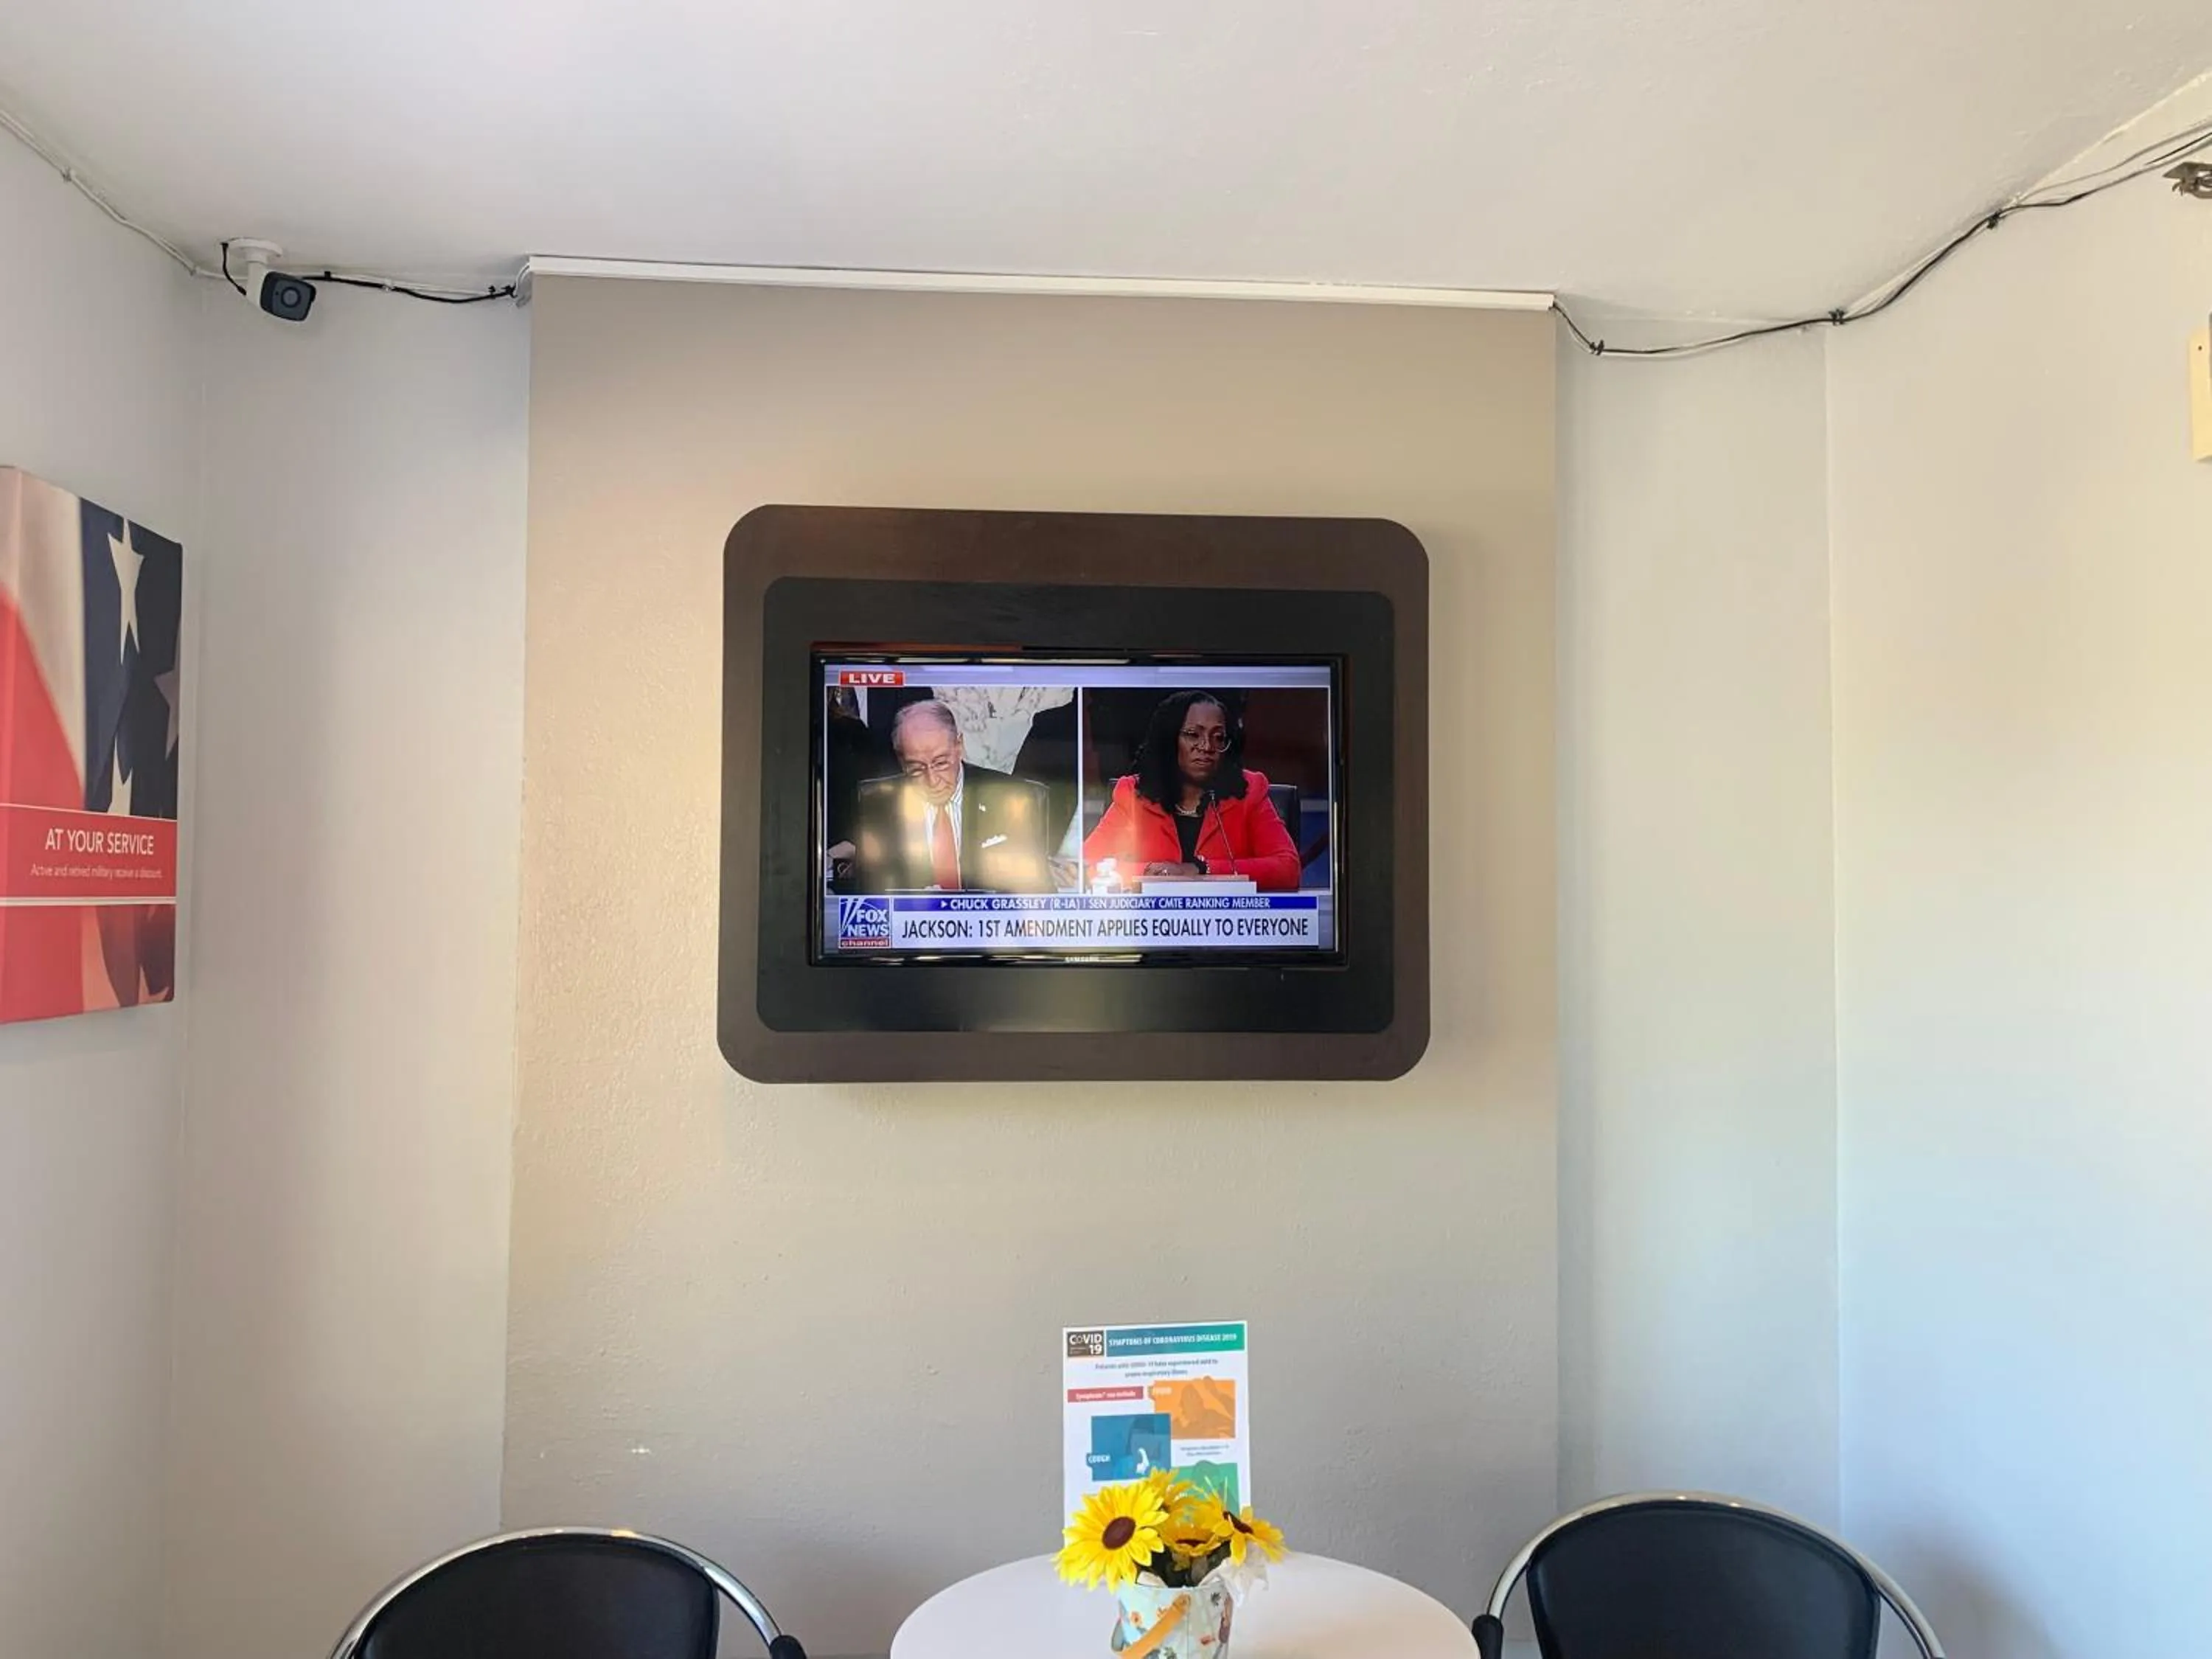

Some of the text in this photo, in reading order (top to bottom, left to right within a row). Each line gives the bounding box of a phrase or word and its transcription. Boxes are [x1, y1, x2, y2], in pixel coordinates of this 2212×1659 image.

[849, 672, 896, 684] LIVE
[45, 828, 154, 855] AT YOUR SERVICE
[30, 863, 52, 877] Active
[55, 865, 67, 877] and
[950, 899, 988, 909] CHUCK
[992, 898, 1046, 910] GRASSLEY
[1089, 898, 1107, 908] SEN
[1109, 897, 1155, 909] JUDICIARY
[1158, 897, 1183, 908] CMTE
[1186, 897, 1230, 908] RANKING
[1232, 897, 1270, 908] MEMBER
[855, 910, 888, 922] FOX
[849, 924, 888, 937] NEWS
[902, 918, 1308, 939] JACKSON: 1ST AMENDMENT APPLIES EQUALLY TO EVERYONE
[841, 939, 888, 947] channel
[1089, 1344, 1102, 1354] 19
[1088, 1454, 1110, 1464] COUGH
